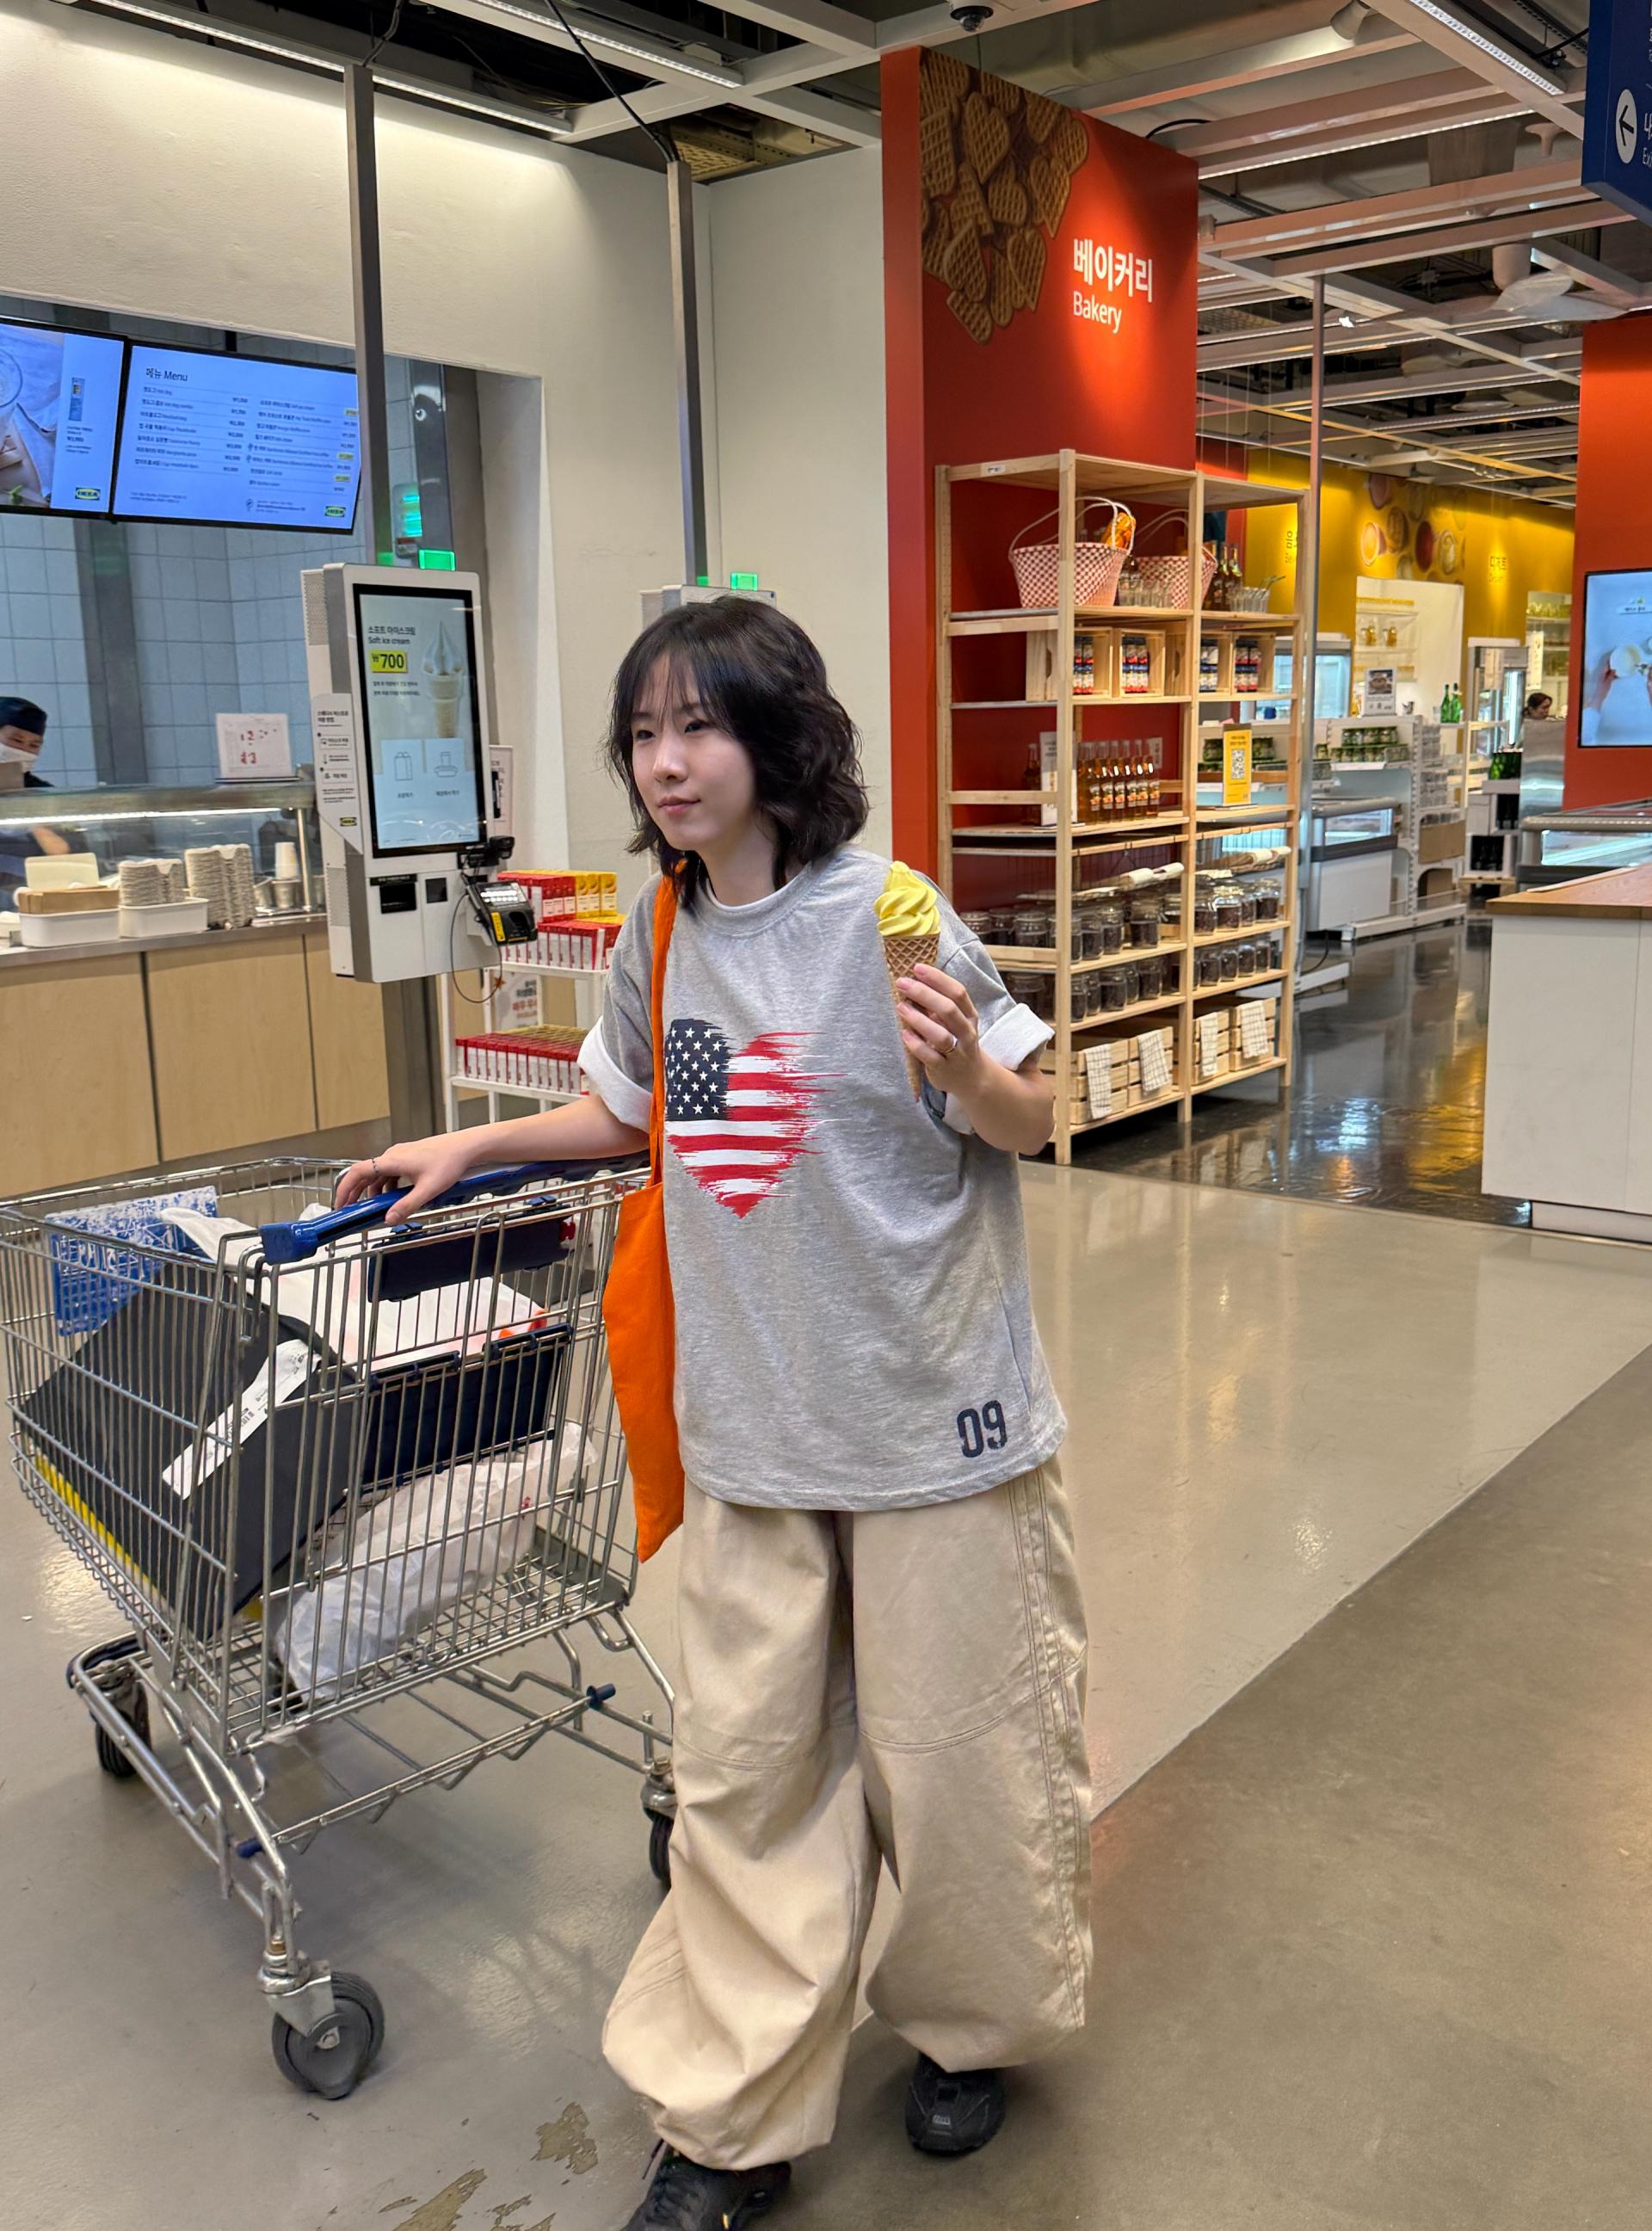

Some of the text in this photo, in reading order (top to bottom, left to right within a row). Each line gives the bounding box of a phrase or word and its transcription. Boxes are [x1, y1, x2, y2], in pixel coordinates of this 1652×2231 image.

[1072, 238, 1153, 303] 베이커리
[1073, 290, 1122, 334] Bakery
[145, 367, 188, 381] 메뉴 Menu
[367, 626, 416, 636] 소프트 아이스크림
[956, 1399, 1008, 1458] 09
